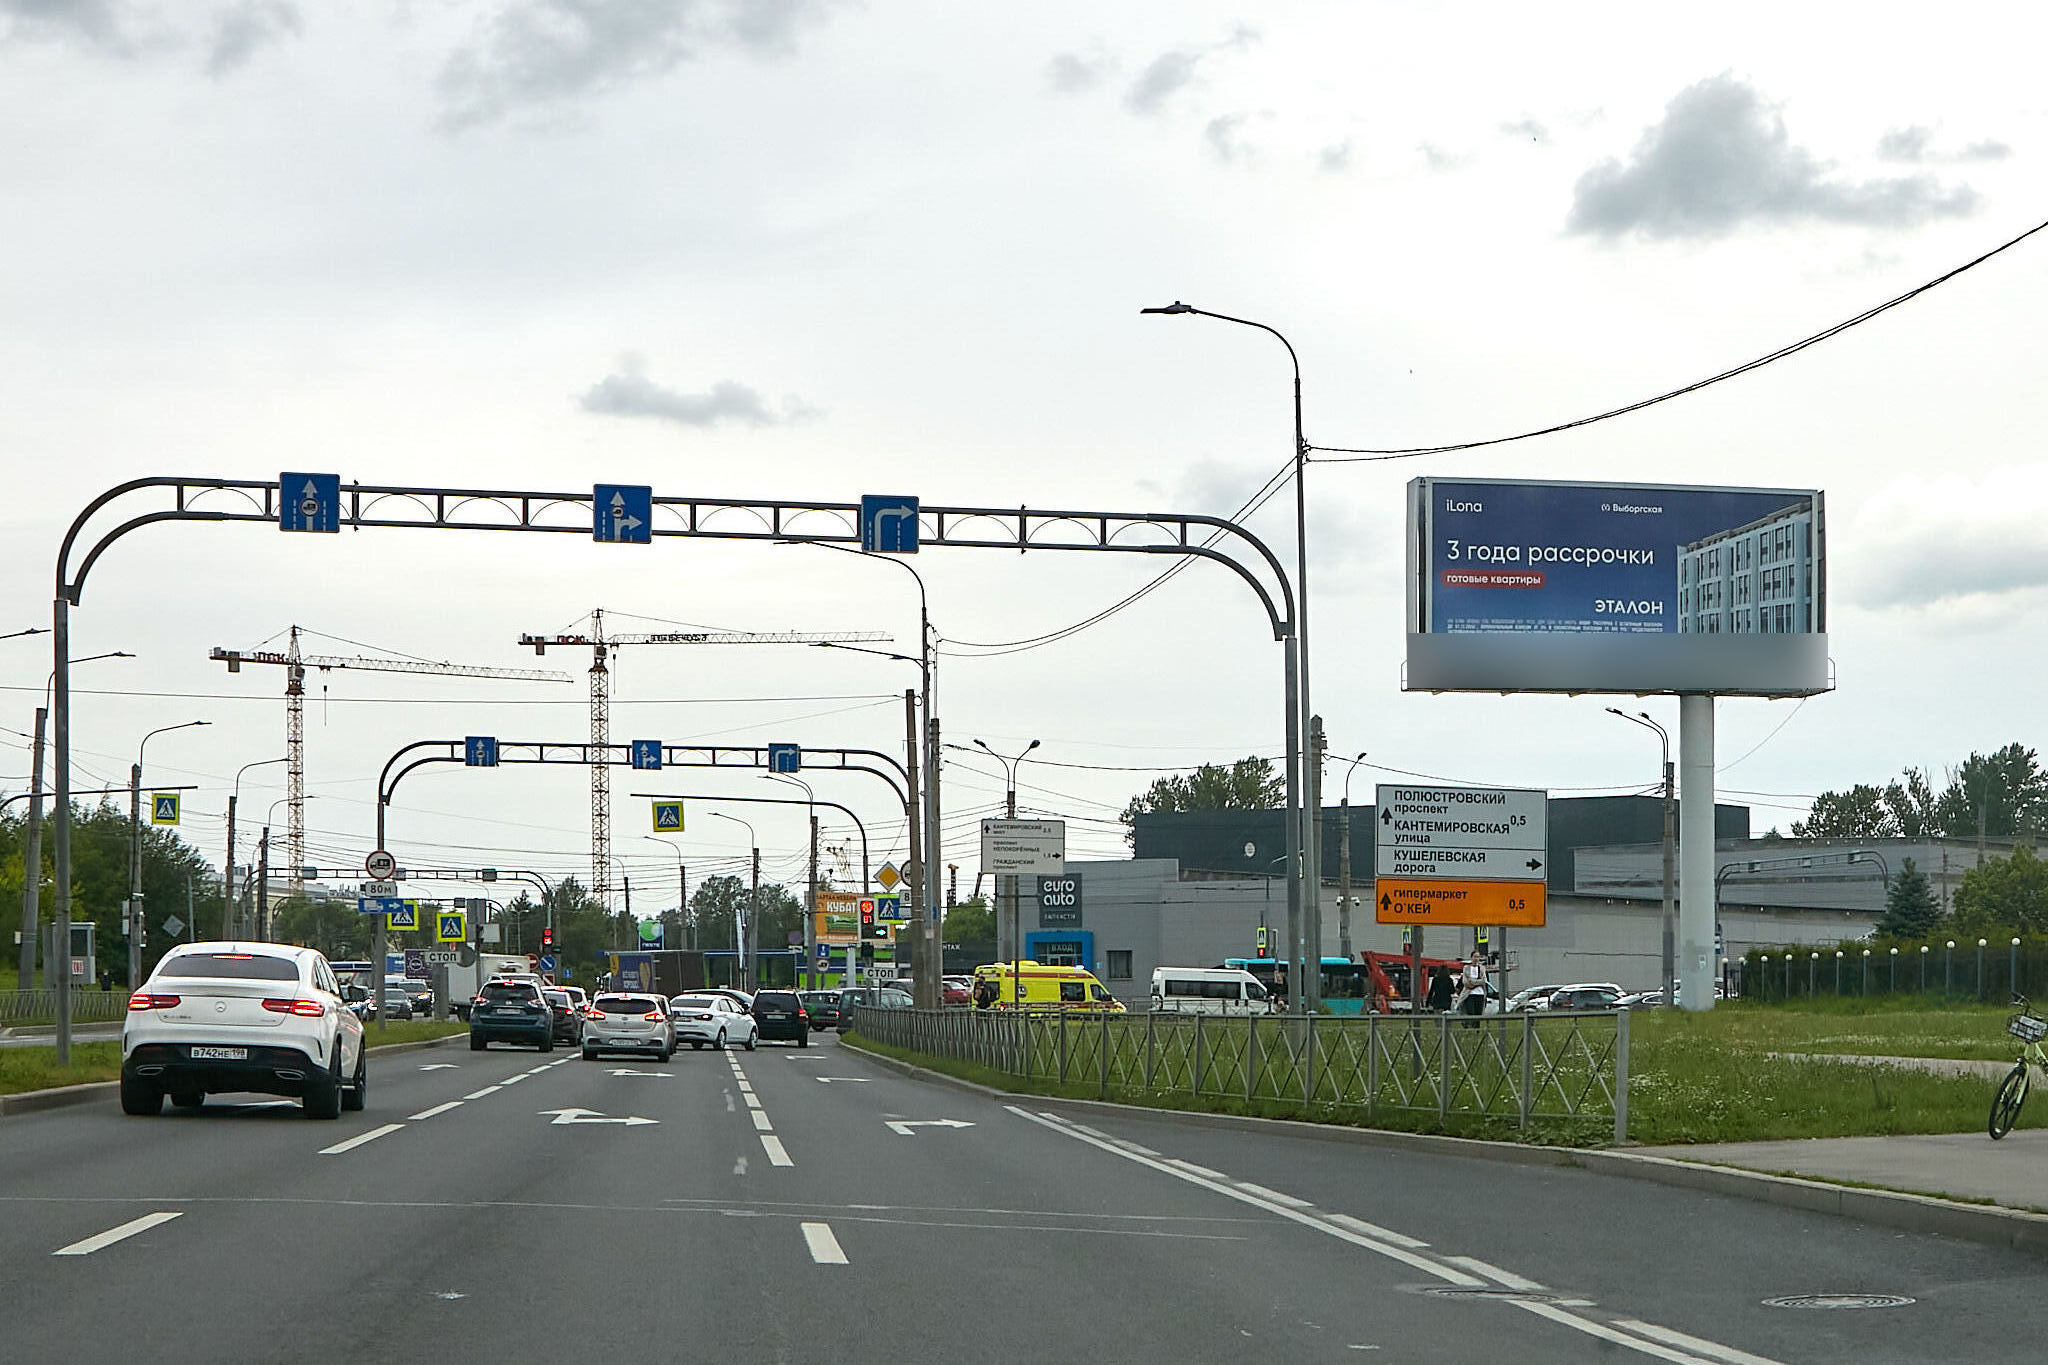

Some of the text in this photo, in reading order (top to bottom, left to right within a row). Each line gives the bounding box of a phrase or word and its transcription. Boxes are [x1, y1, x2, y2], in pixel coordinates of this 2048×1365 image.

[1446, 499, 1482, 512] iLona
[1613, 503, 1662, 514] Выборгская
[1447, 540, 1655, 567] 3 года рассрочки
[1447, 575, 1541, 585] готовые квартиры
[1595, 600, 1663, 615] ЭТАЛОН
[1394, 790, 1506, 804] ПОЛЮСТРОВСКИЙ
[1394, 804, 1448, 814] проспект
[1394, 820, 1510, 834] КАНТЕМИРОВСКАЯ
[1510, 815, 1526, 827] 0,5
[1394, 834, 1431, 844] улица
[1394, 850, 1486, 862] КУШЕЛЕВСКАЯ
[1394, 864, 1436, 874] дорога
[370, 885, 392, 894] 80м
[1043, 880, 1075, 892] euro
[1043, 892, 1075, 906] auto
[1394, 889, 1468, 901] гипермаркет
[1509, 899, 1525, 911] 0,5
[1051, 944, 1073, 952] ВХОД
[429, 953, 457, 961] СТОП
[867, 969, 894, 978] СТОП
